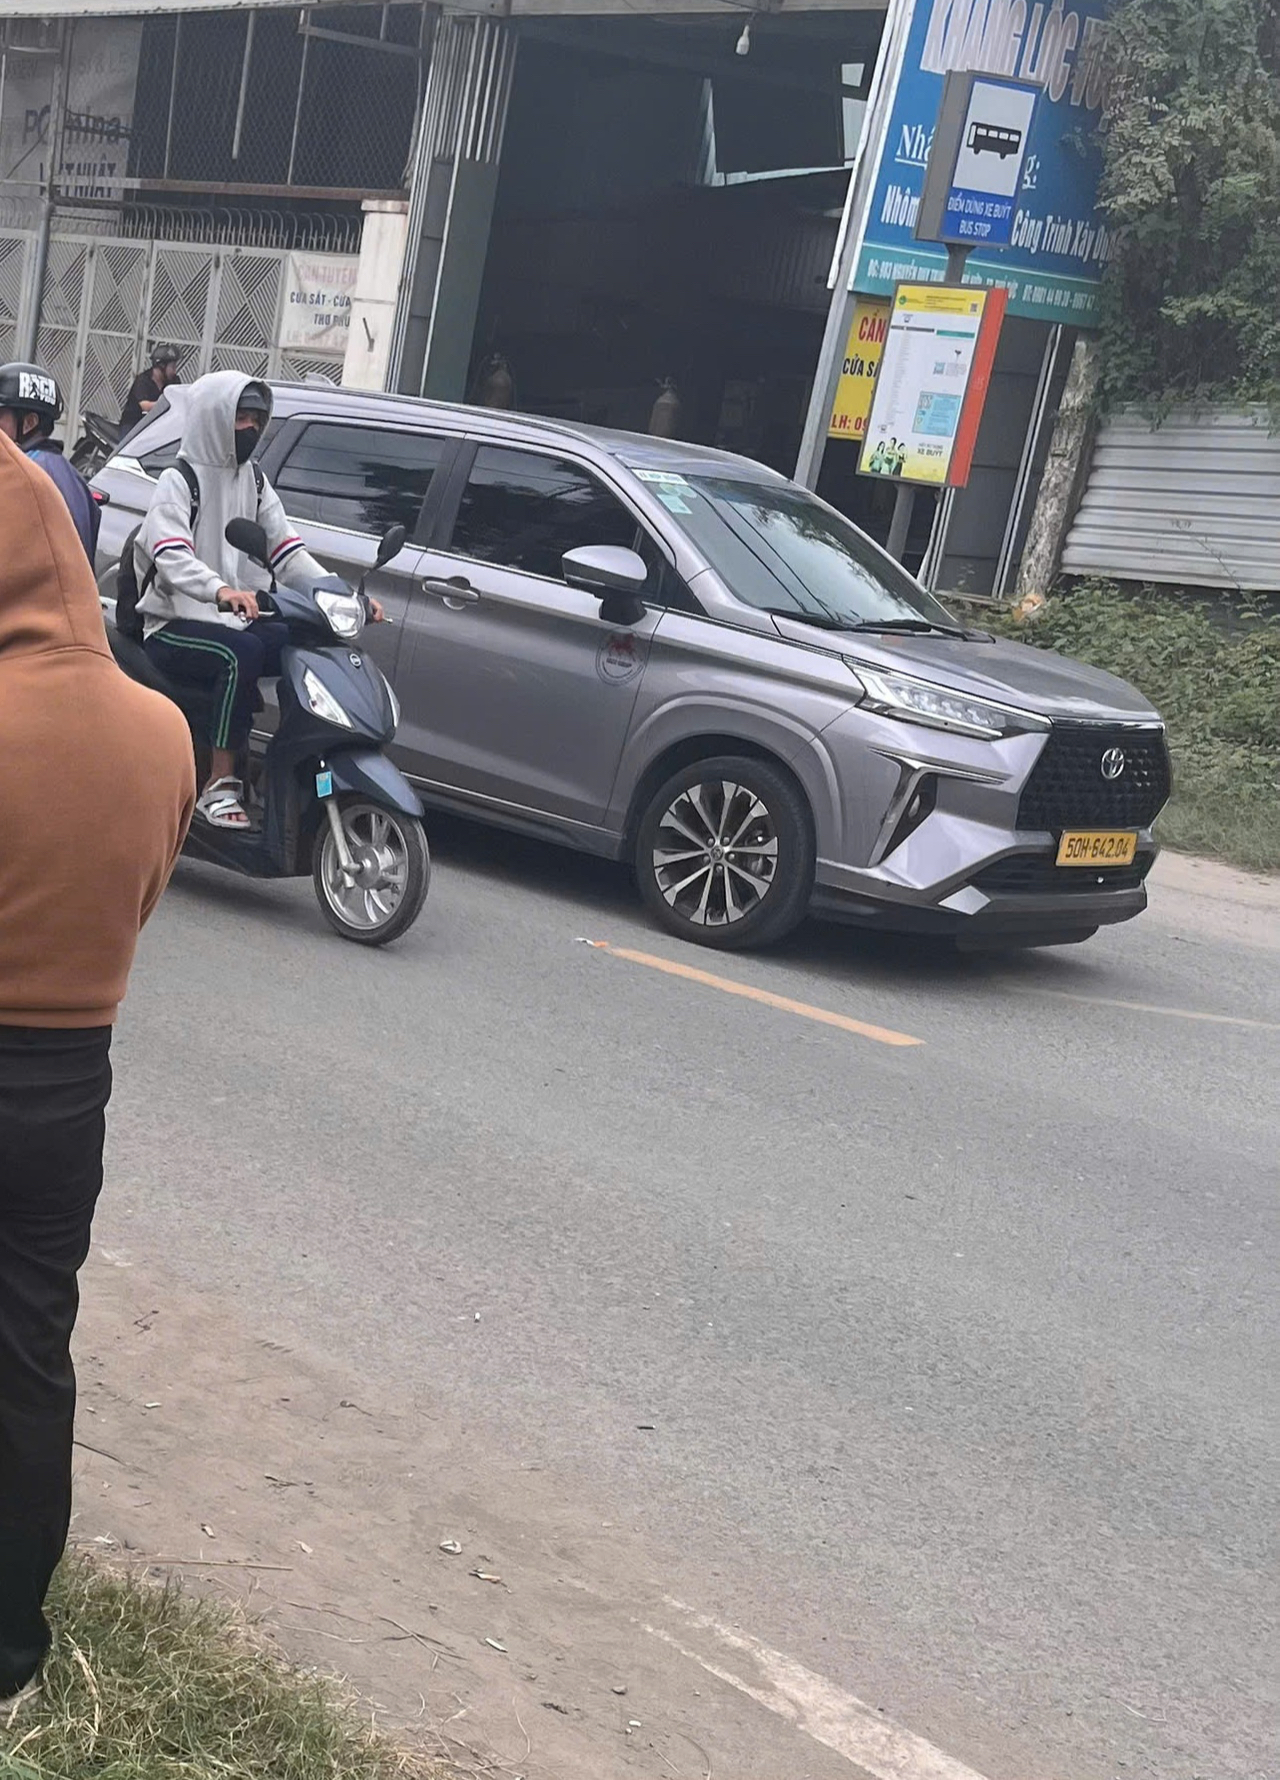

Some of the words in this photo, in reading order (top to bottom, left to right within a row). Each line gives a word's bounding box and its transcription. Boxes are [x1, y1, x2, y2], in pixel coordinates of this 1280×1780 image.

[959, 219, 974, 235] BUS
[973, 222, 991, 237] STOP
[1010, 208, 1043, 255] Công
[1041, 215, 1073, 255] Trình
[1069, 220, 1096, 263] Xây
[842, 353, 864, 377] CỬA
[831, 414, 852, 430] LH:
